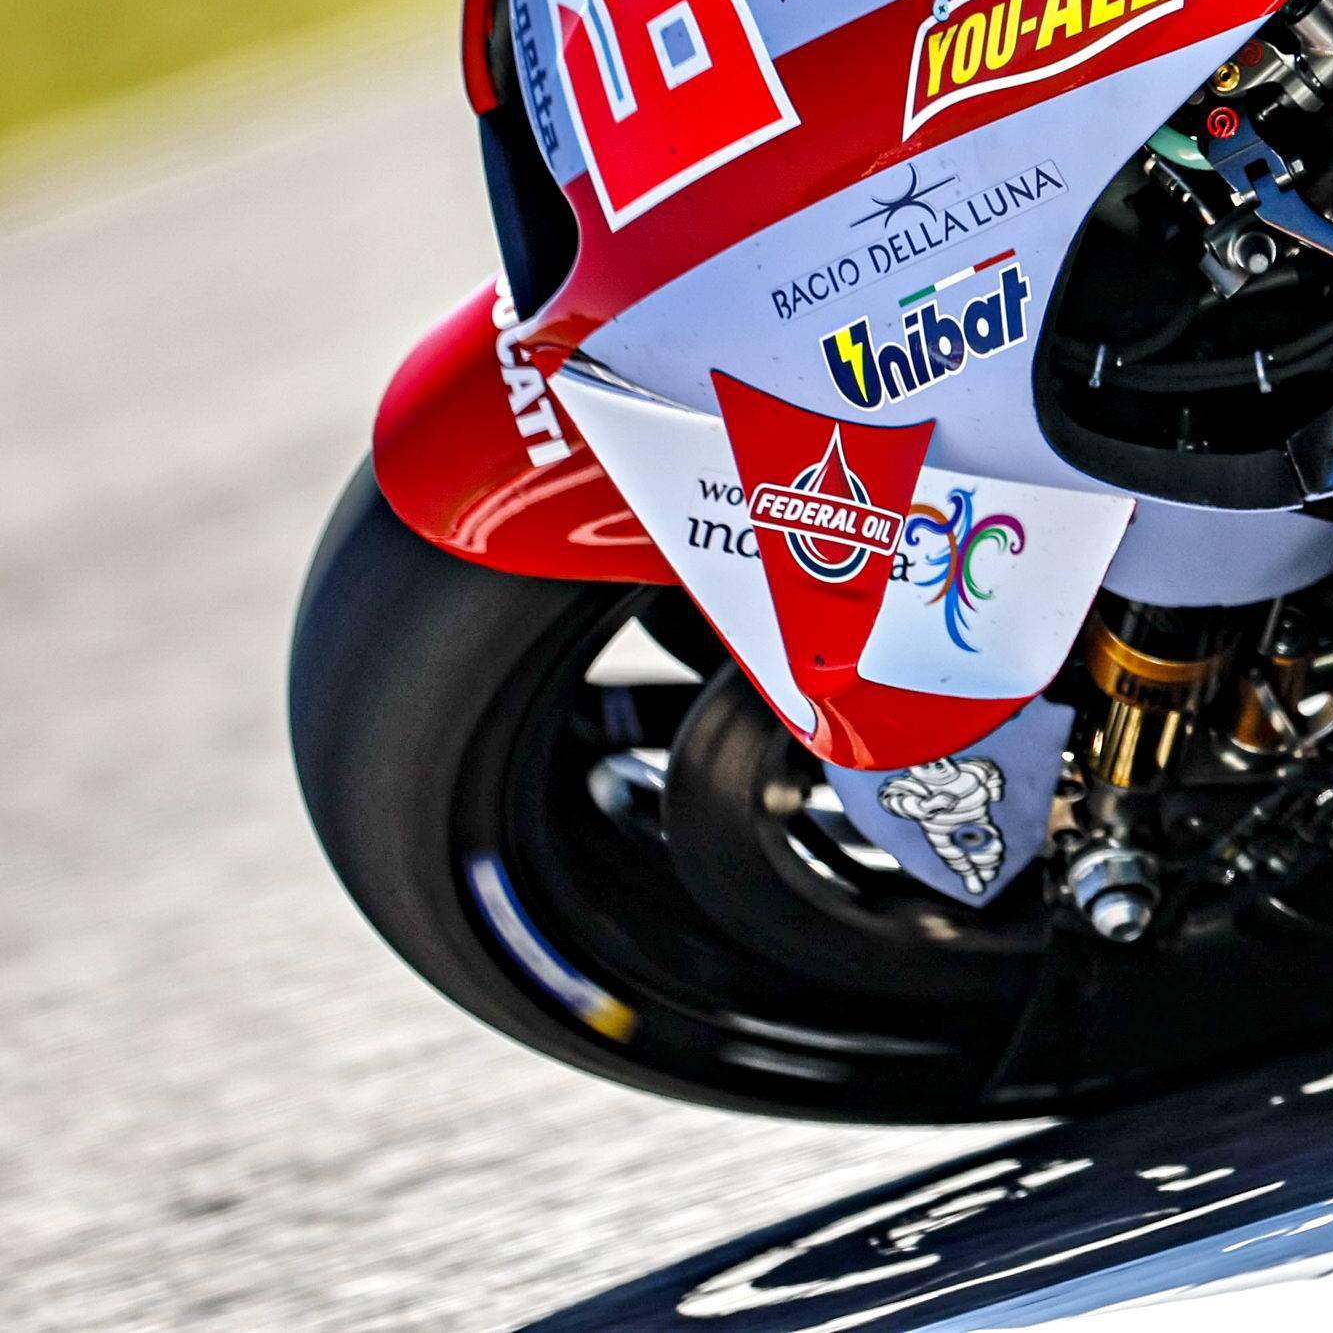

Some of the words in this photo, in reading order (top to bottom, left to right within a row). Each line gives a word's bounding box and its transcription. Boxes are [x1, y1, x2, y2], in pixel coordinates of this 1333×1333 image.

[771, 258, 862, 321] BACIO
[868, 215, 968, 273] DELLA
[973, 165, 1064, 227] LUNA
[820, 261, 1031, 410] Unibat
[756, 493, 857, 535] FEDERAL
[862, 516, 893, 544] OIL
